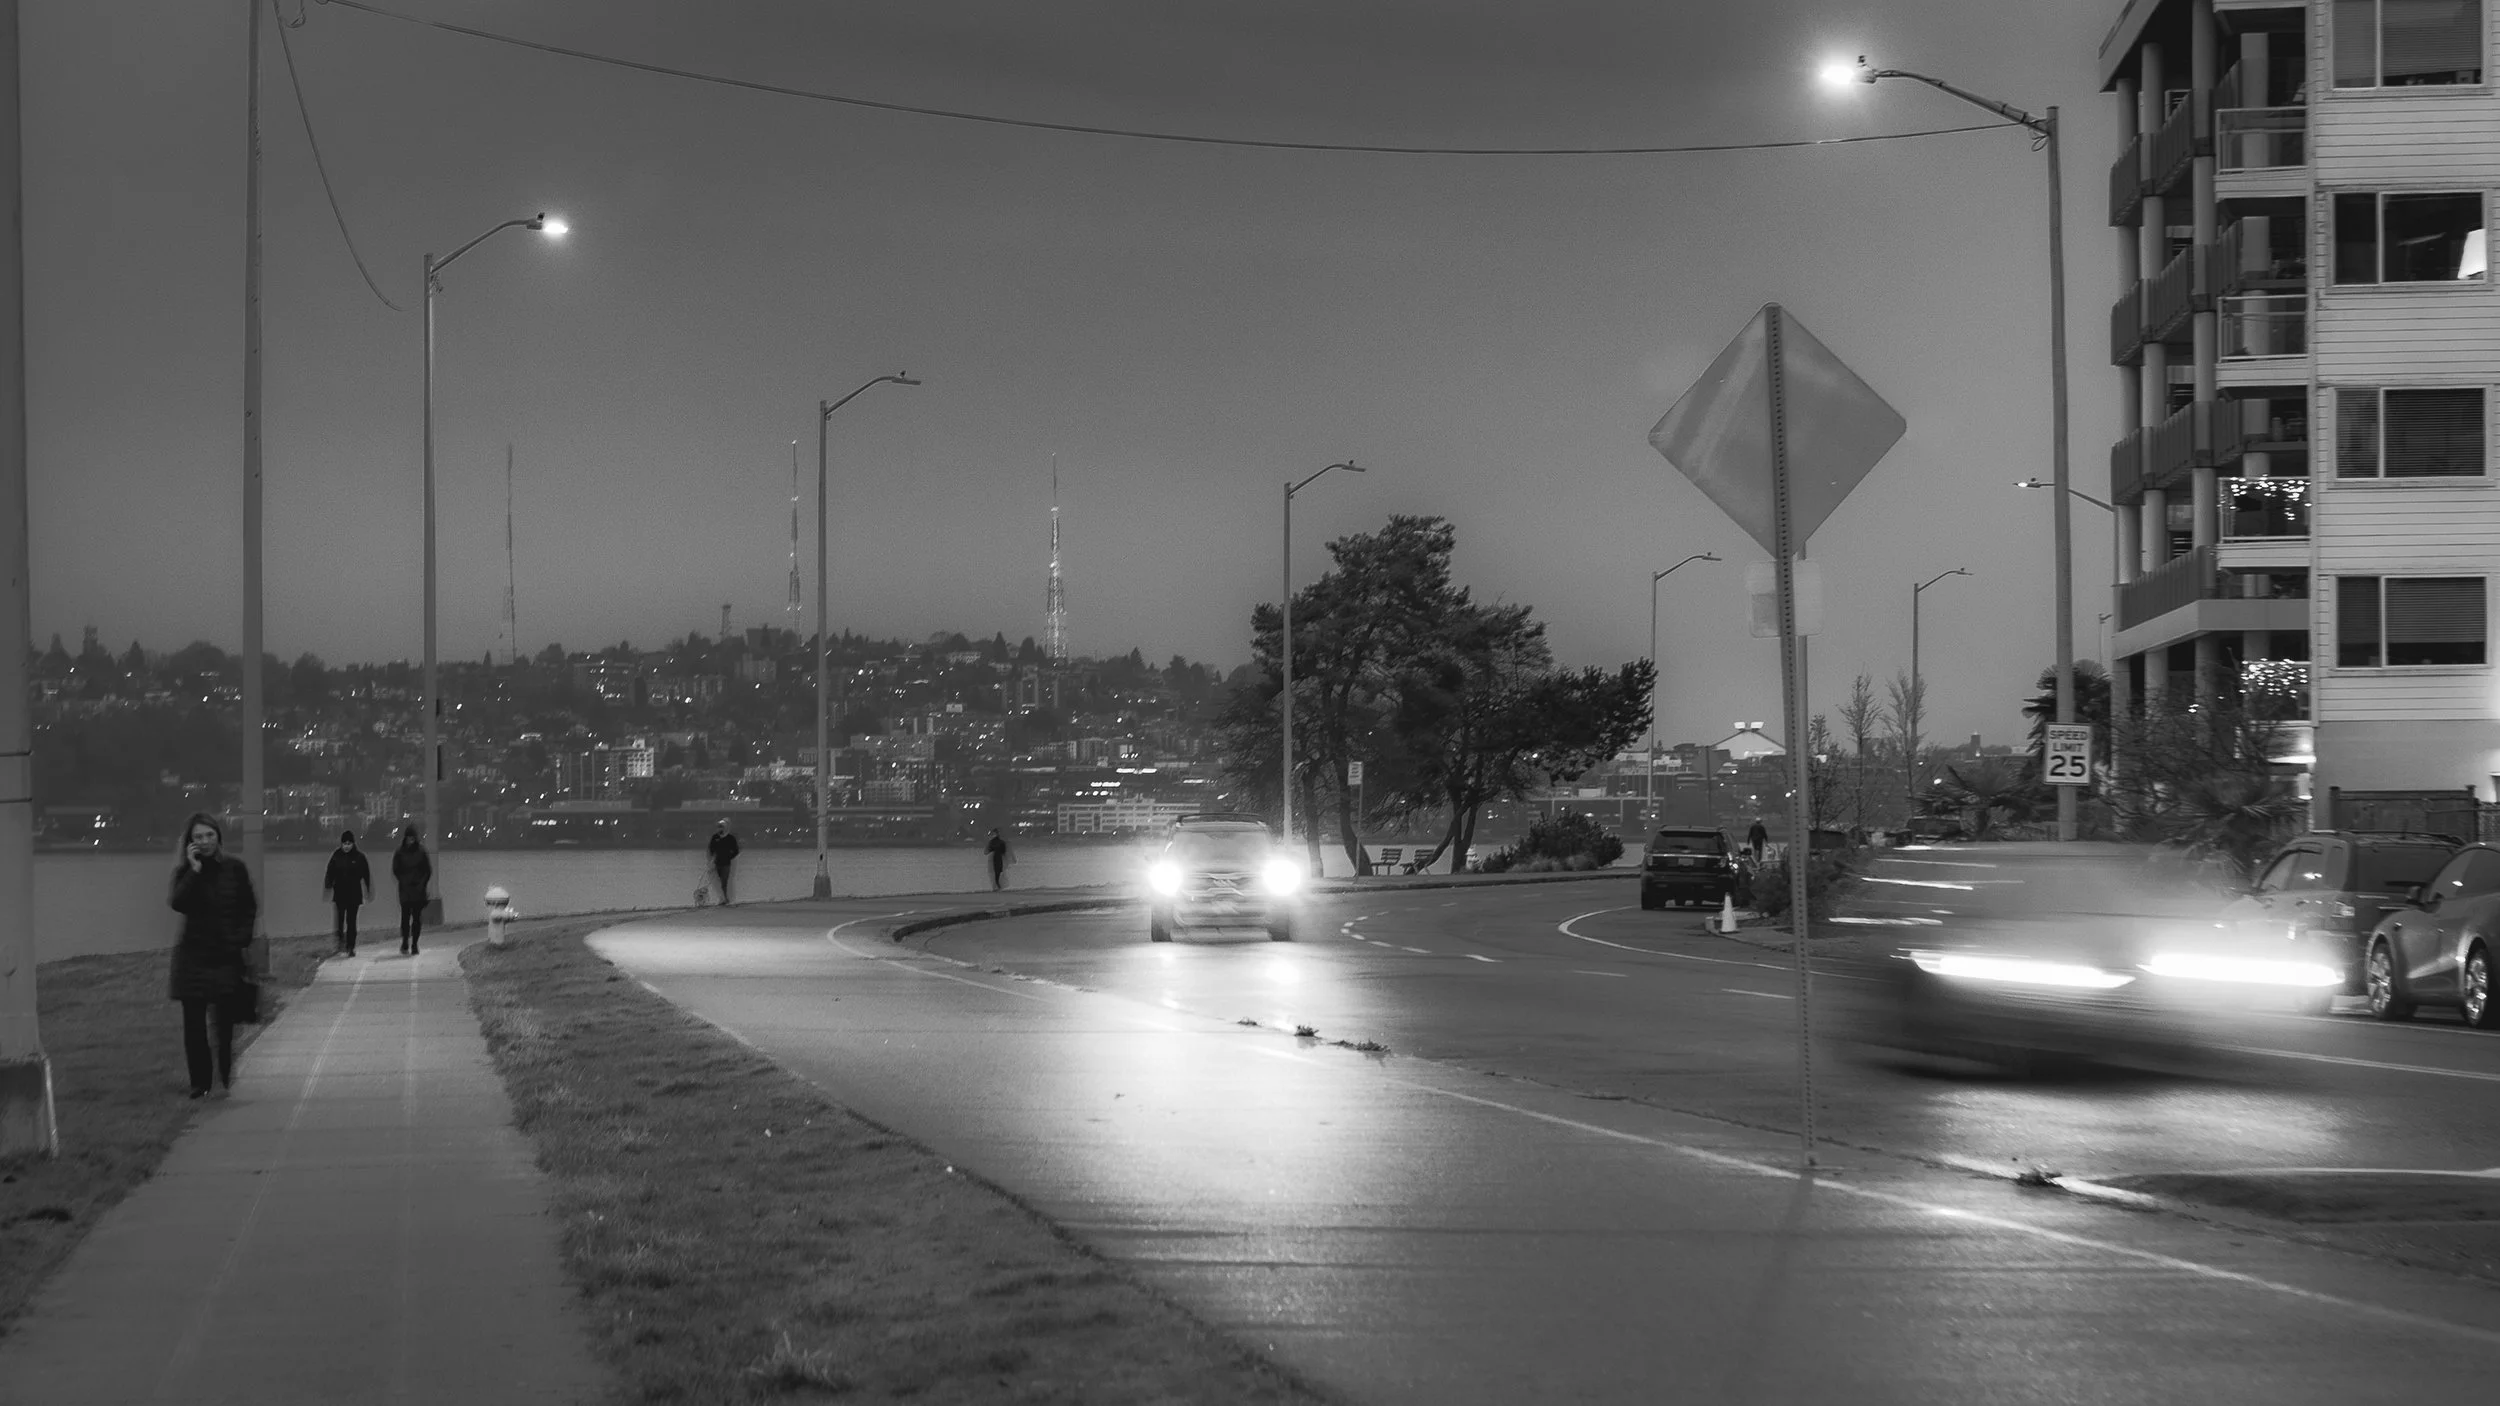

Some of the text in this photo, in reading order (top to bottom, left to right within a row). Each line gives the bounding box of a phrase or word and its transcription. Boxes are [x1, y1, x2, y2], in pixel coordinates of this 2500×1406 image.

[2049, 730, 2087, 740] SPEED
[2053, 742, 2084, 752] LIMIT
[2049, 755, 2087, 777] 25
